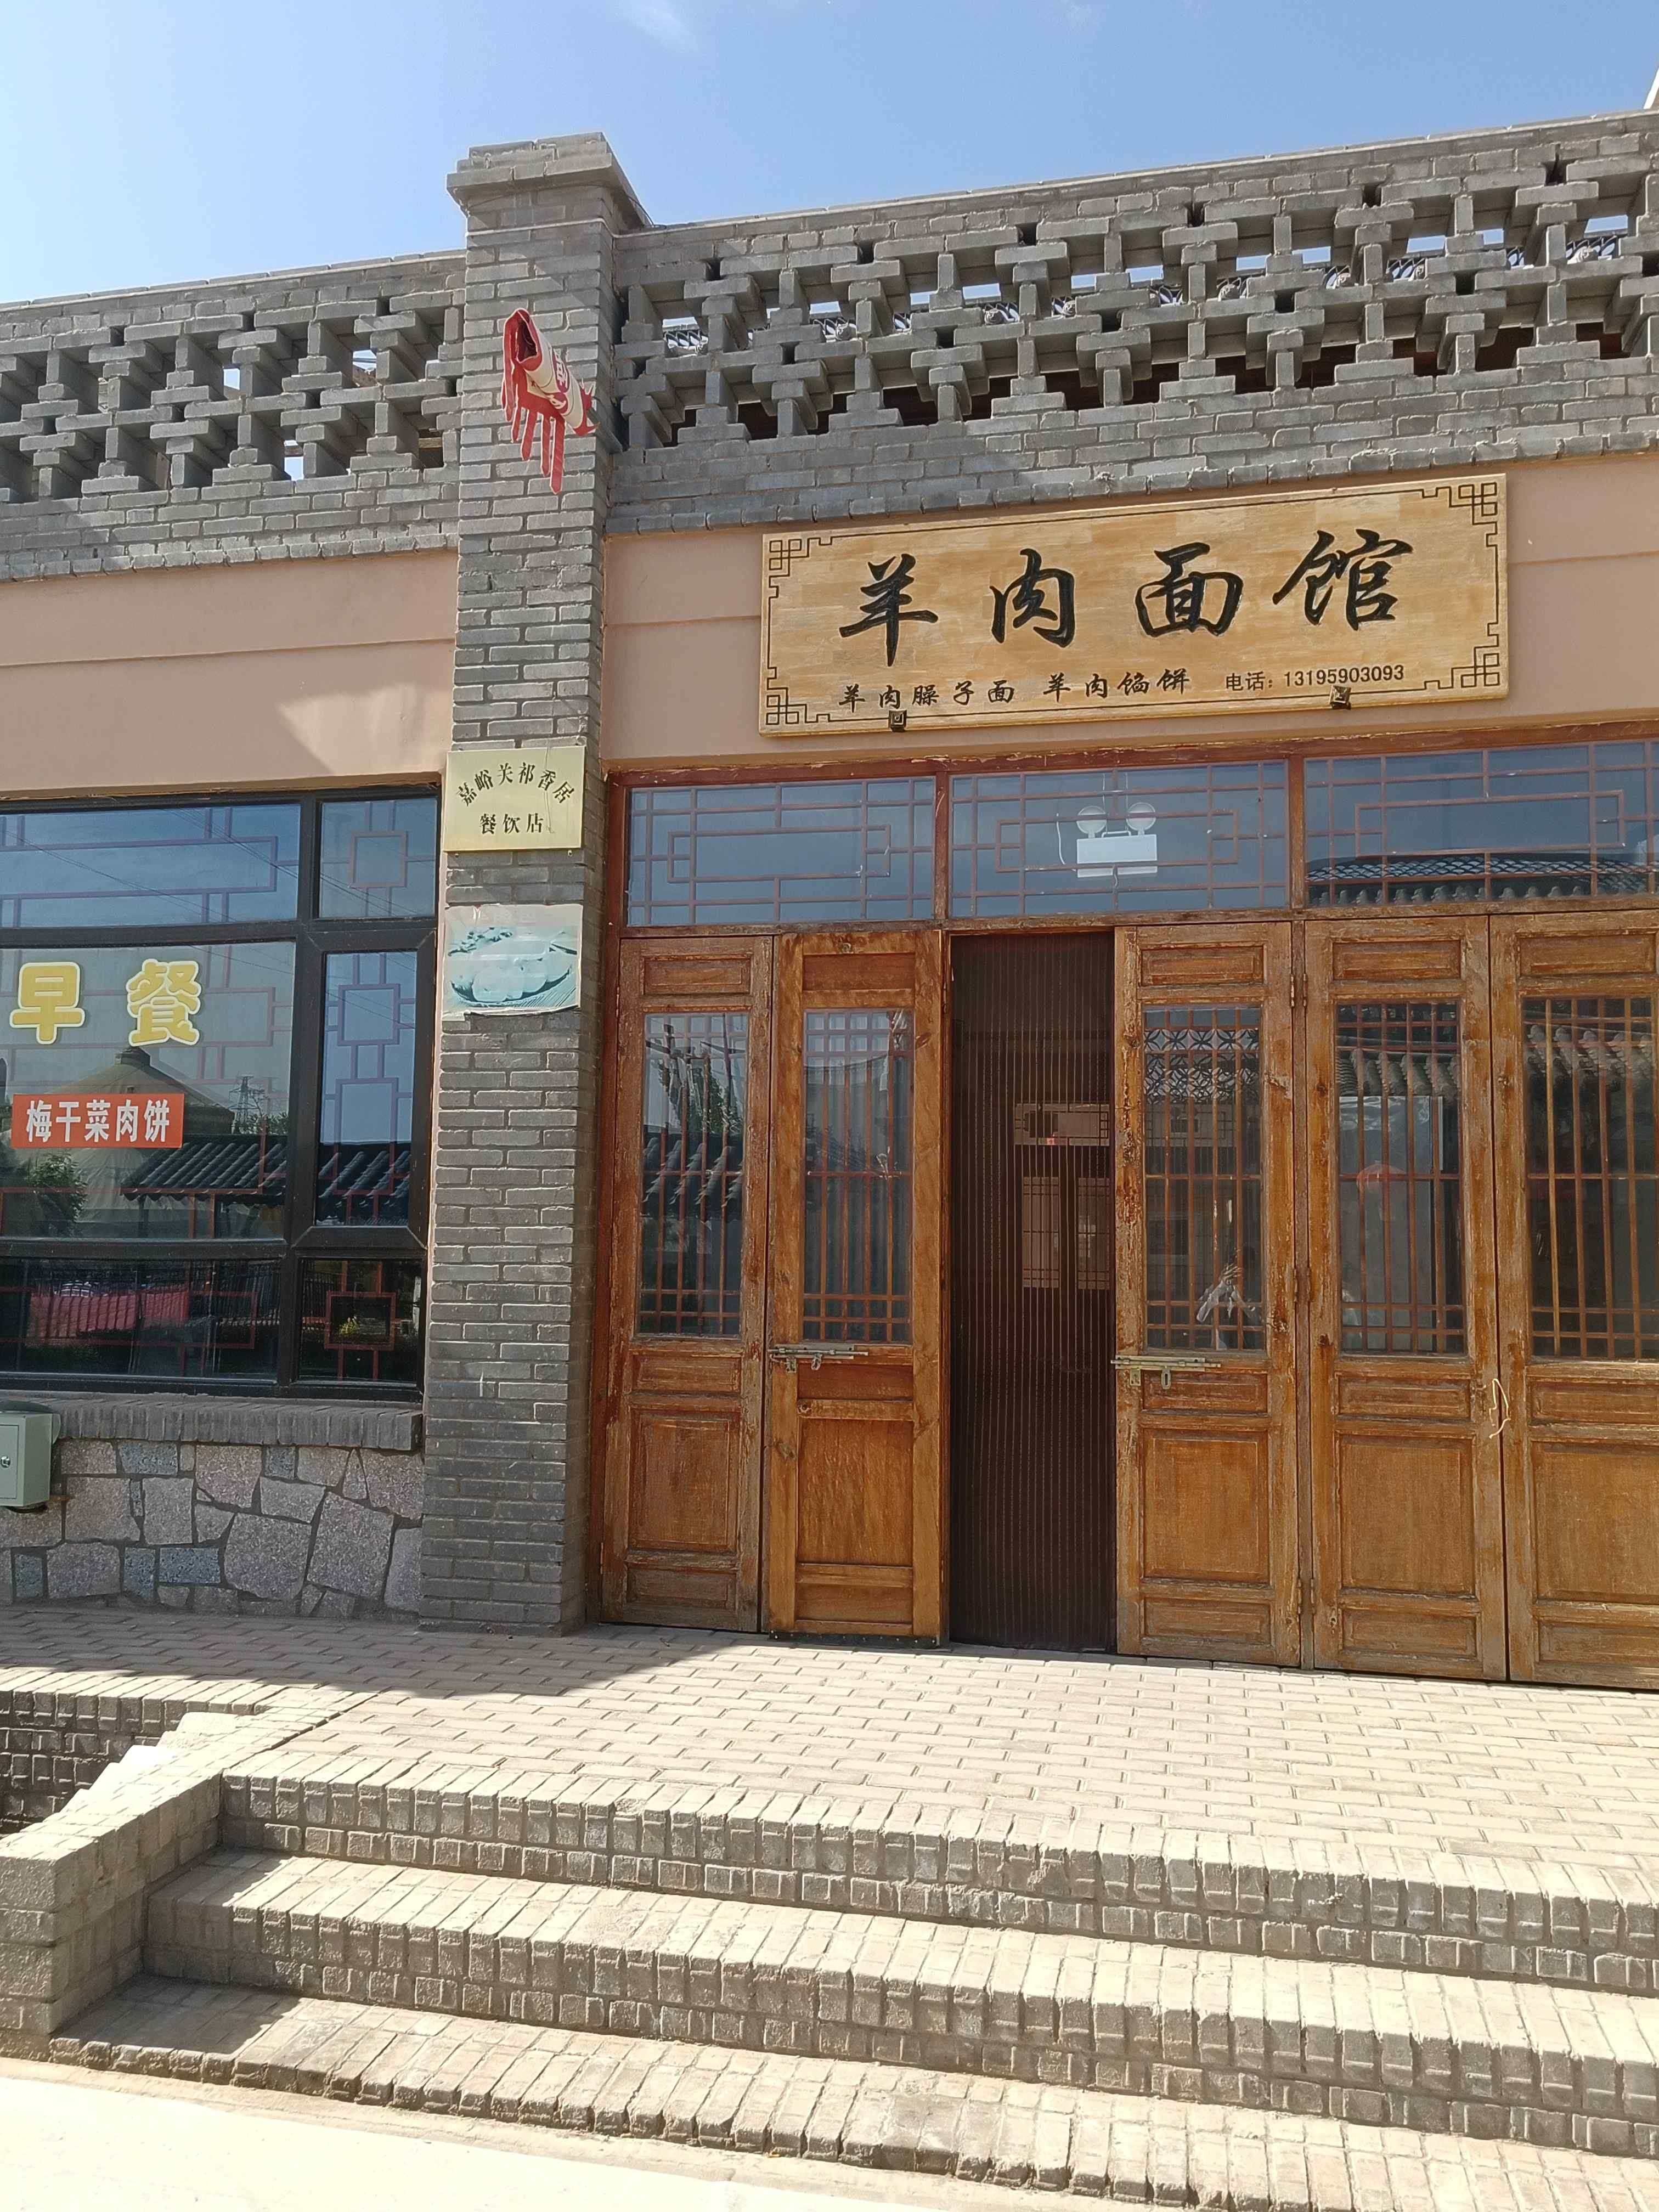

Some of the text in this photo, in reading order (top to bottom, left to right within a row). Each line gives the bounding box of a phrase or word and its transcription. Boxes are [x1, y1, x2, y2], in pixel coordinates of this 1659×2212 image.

[839, 529, 1413, 666] 羊肉面馆
[838, 680, 1015, 713] 羊肉臊子面
[1043, 668, 1190, 703] 羊肉馅饼
[456, 762, 575, 806] 嘉峪关祁香居
[479, 813, 544, 835] 餐饮店
[10, 958, 201, 1047] 早餐
[26, 1099, 170, 1143] 梅干菜肉饼
